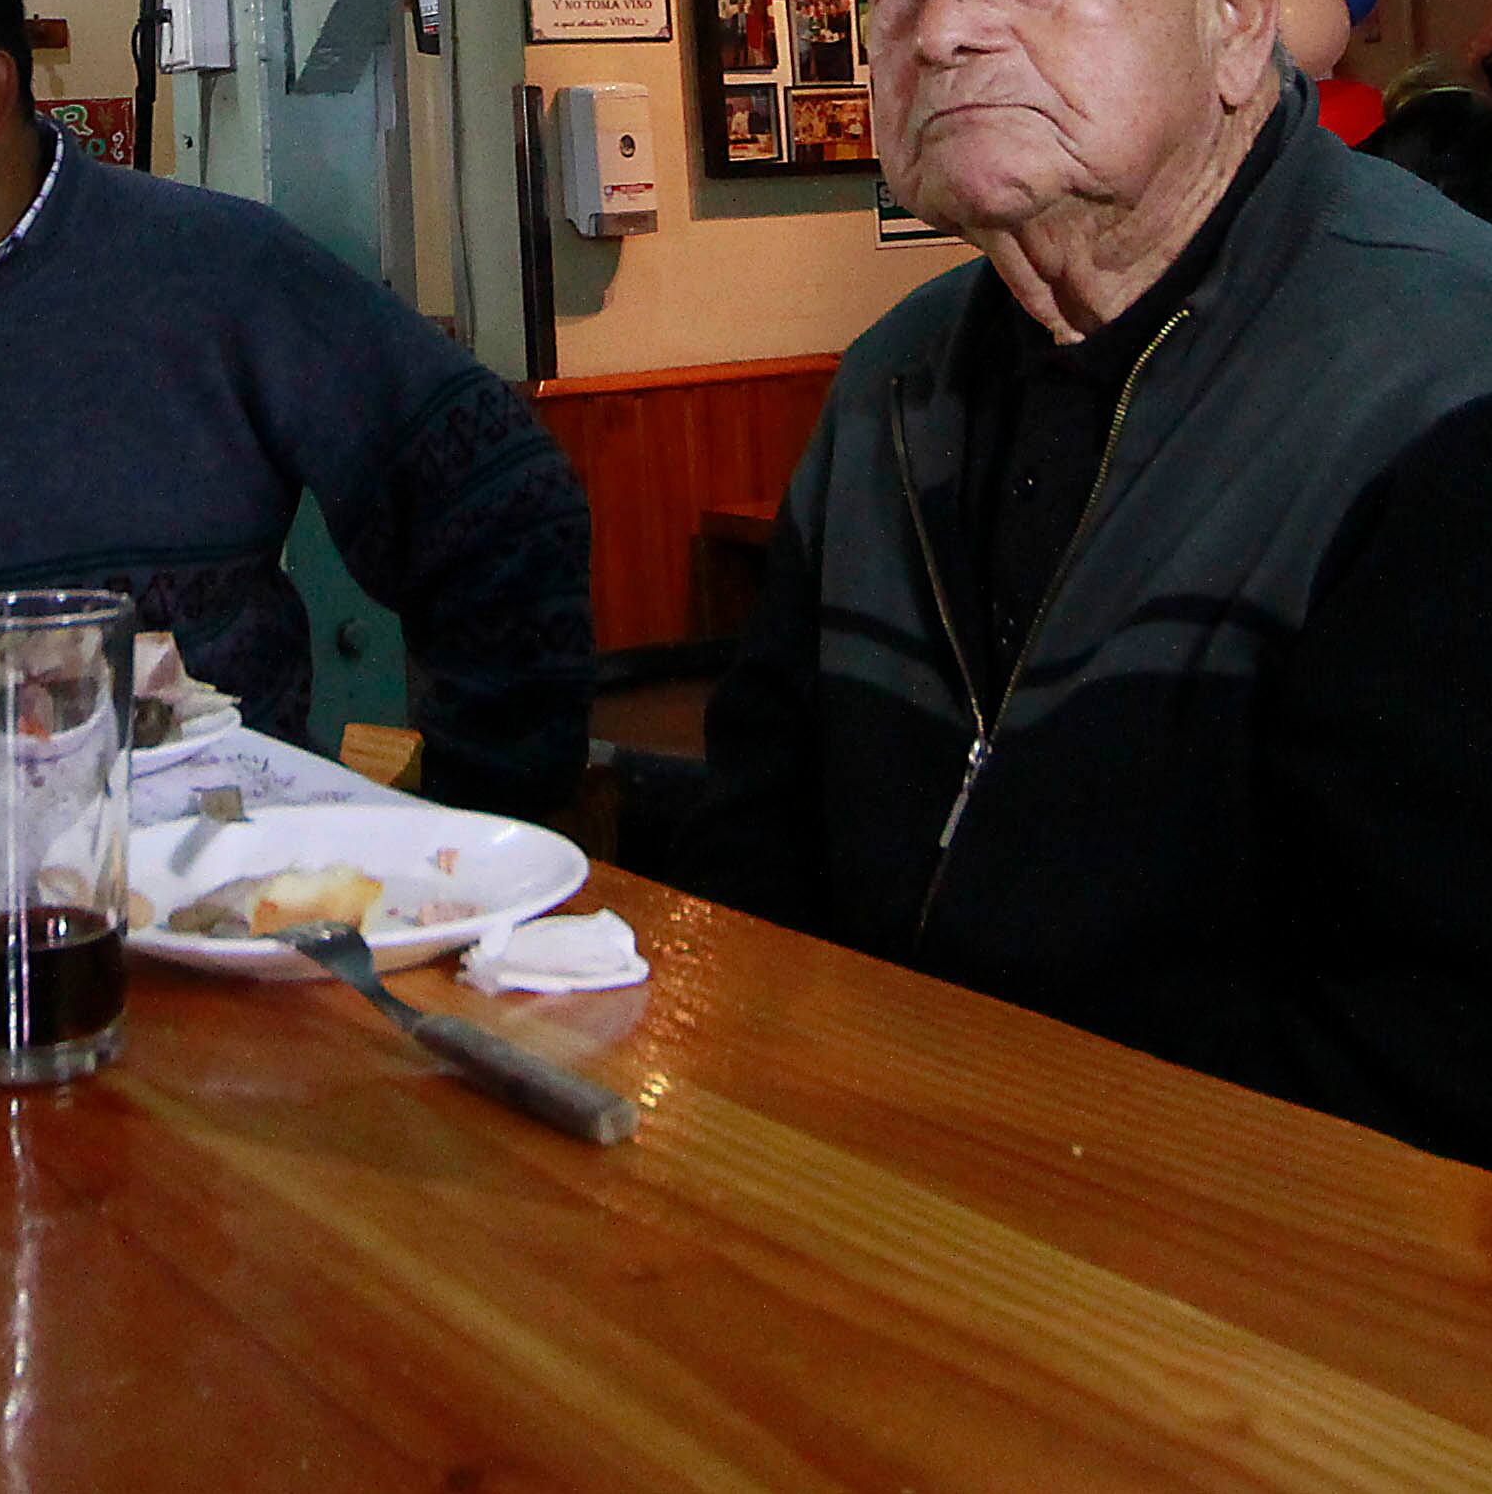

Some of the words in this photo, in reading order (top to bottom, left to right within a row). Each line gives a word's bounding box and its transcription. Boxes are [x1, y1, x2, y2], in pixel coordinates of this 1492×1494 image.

[552, 0, 562, 10] Y
[565, 0, 581, 9] NO
[586, 0, 620, 9] TOMA
[623, 0, 653, 9] VINO
